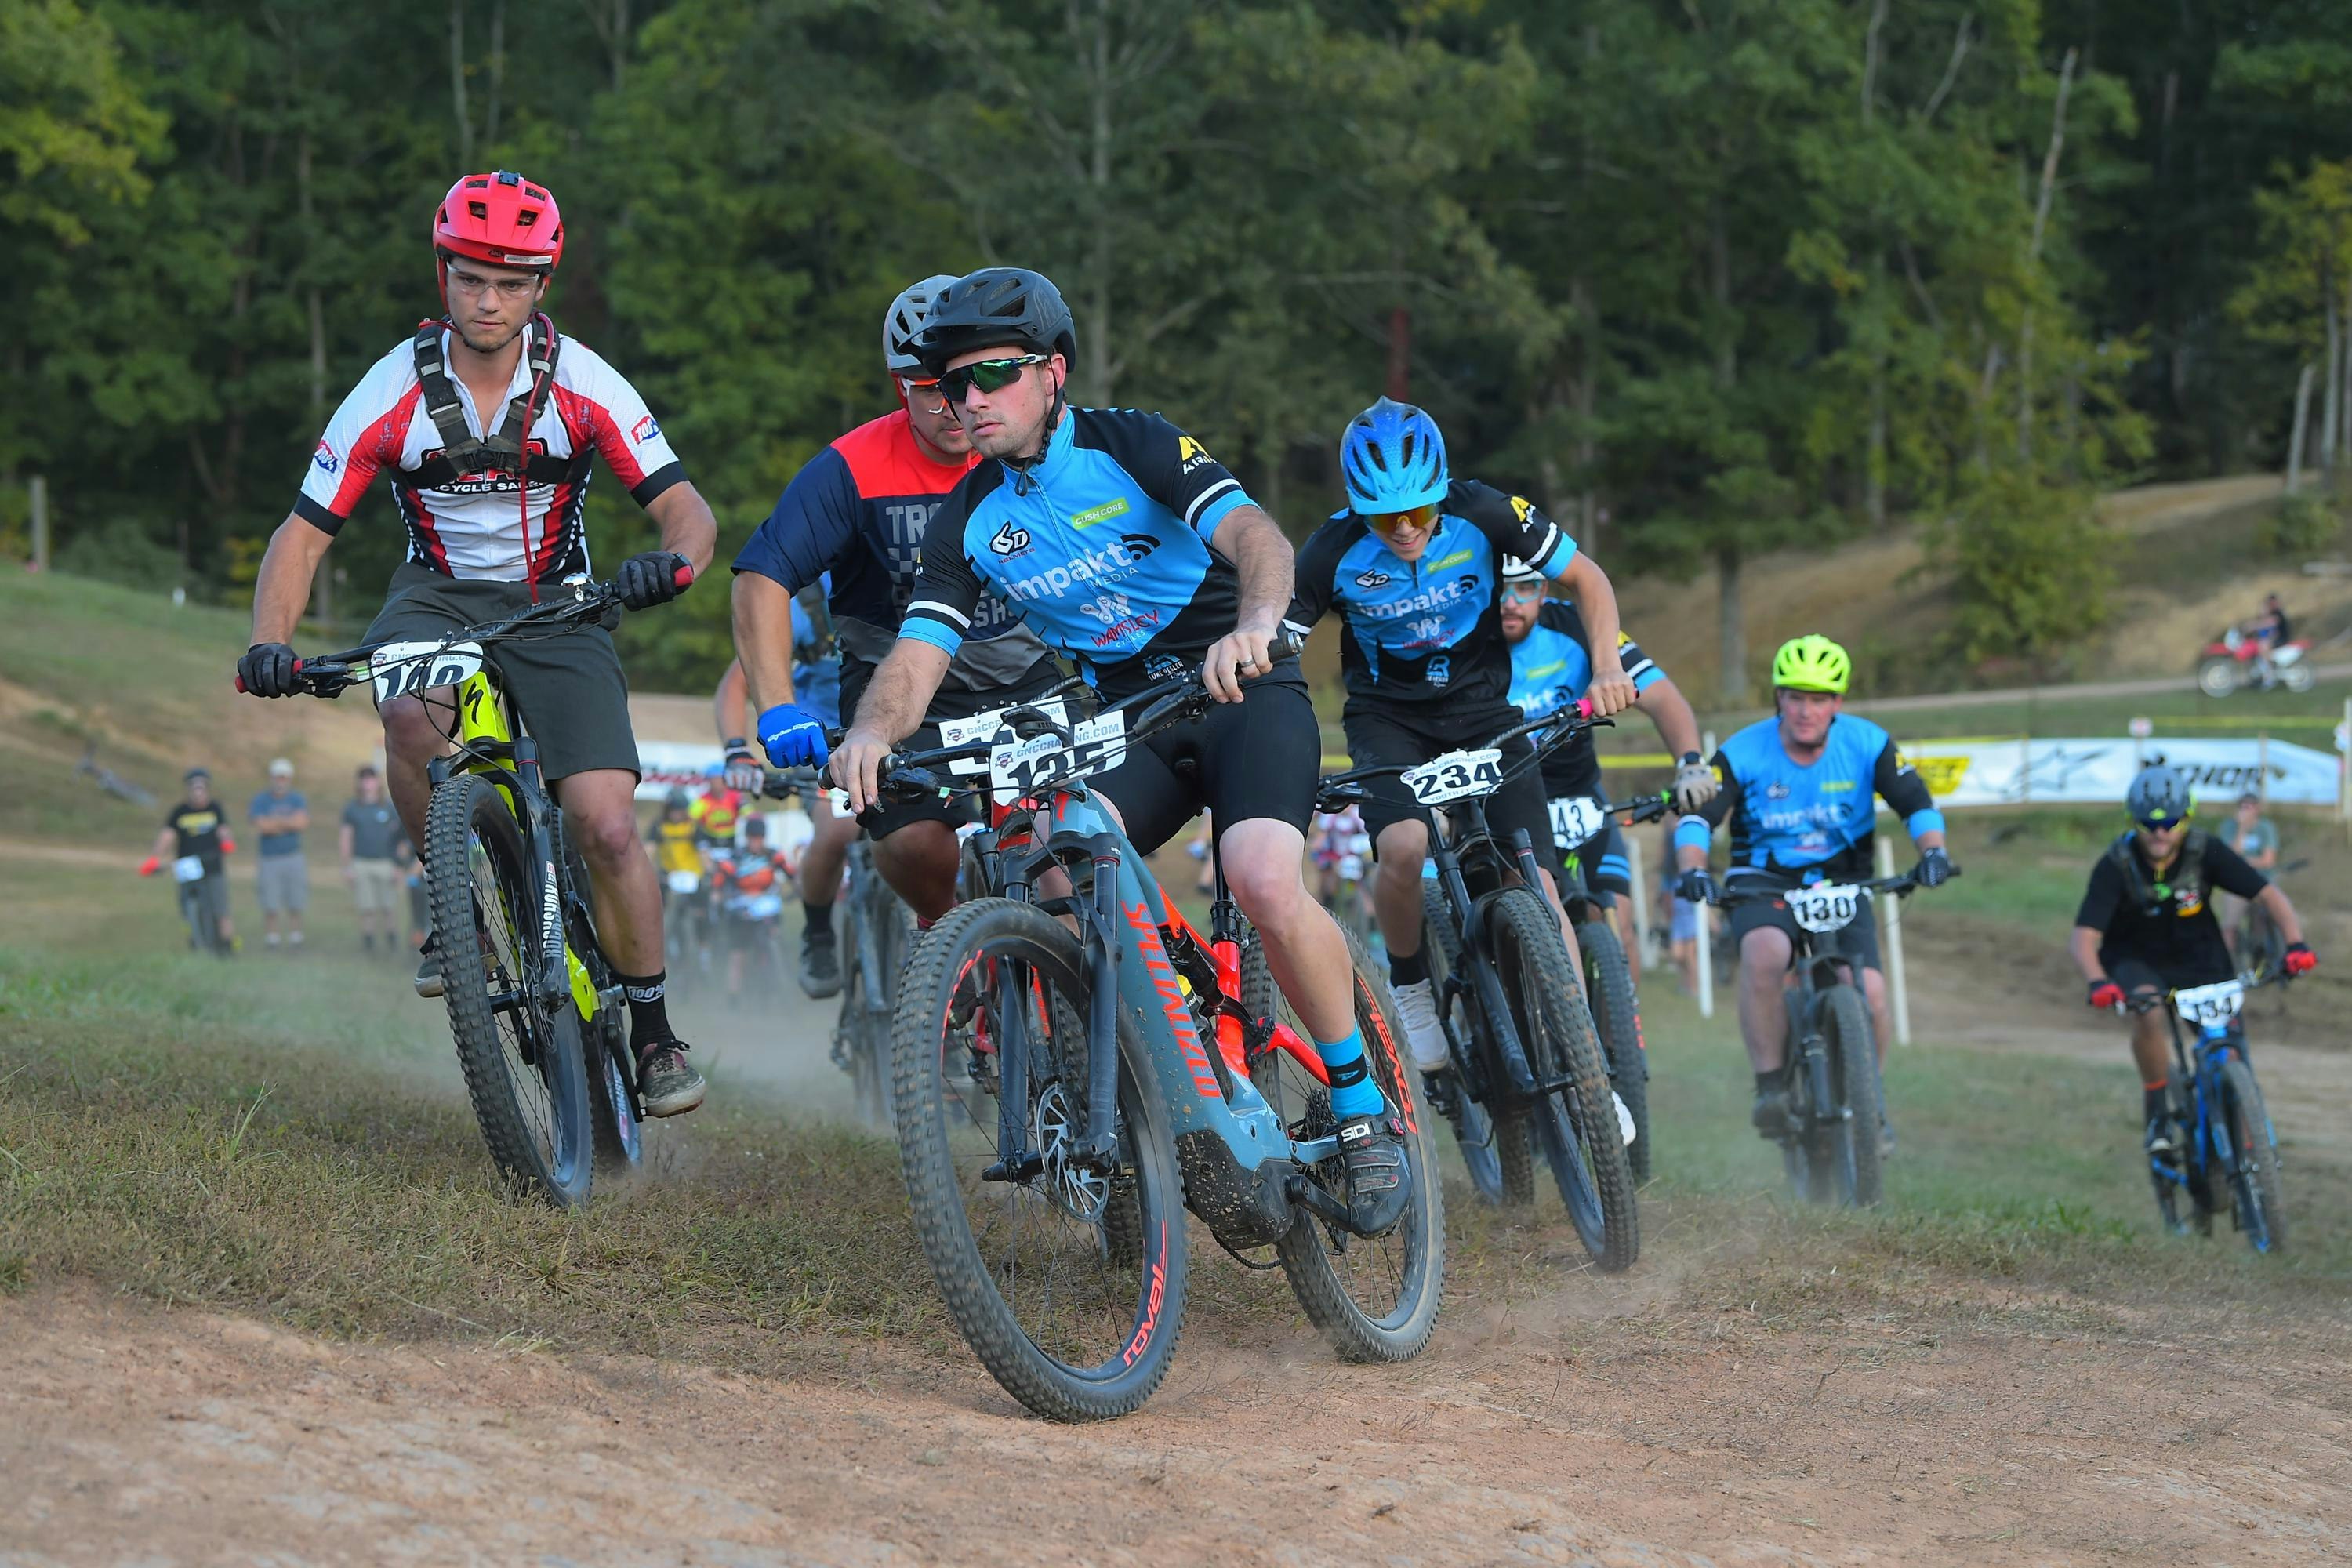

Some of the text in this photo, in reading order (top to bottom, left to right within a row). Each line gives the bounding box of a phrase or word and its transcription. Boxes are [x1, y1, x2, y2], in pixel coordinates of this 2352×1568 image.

[435, 483, 492, 492] CYCLE
[1100, 502, 1124, 516] CORE
[989, 521, 1030, 555] 6D
[998, 547, 1036, 565] HELMETS
[999, 542, 1133, 602] impakt
[1088, 566, 1140, 588] MEDIA
[1091, 609, 1159, 648] WAMSLEY
[1413, 761, 1501, 799] 234
[1798, 897, 1852, 923] 130
[1120, 900, 1221, 1098] SPECIALIZED
[1341, 1123, 1371, 1143] SIDI
[1123, 1263, 1165, 1367] roval
